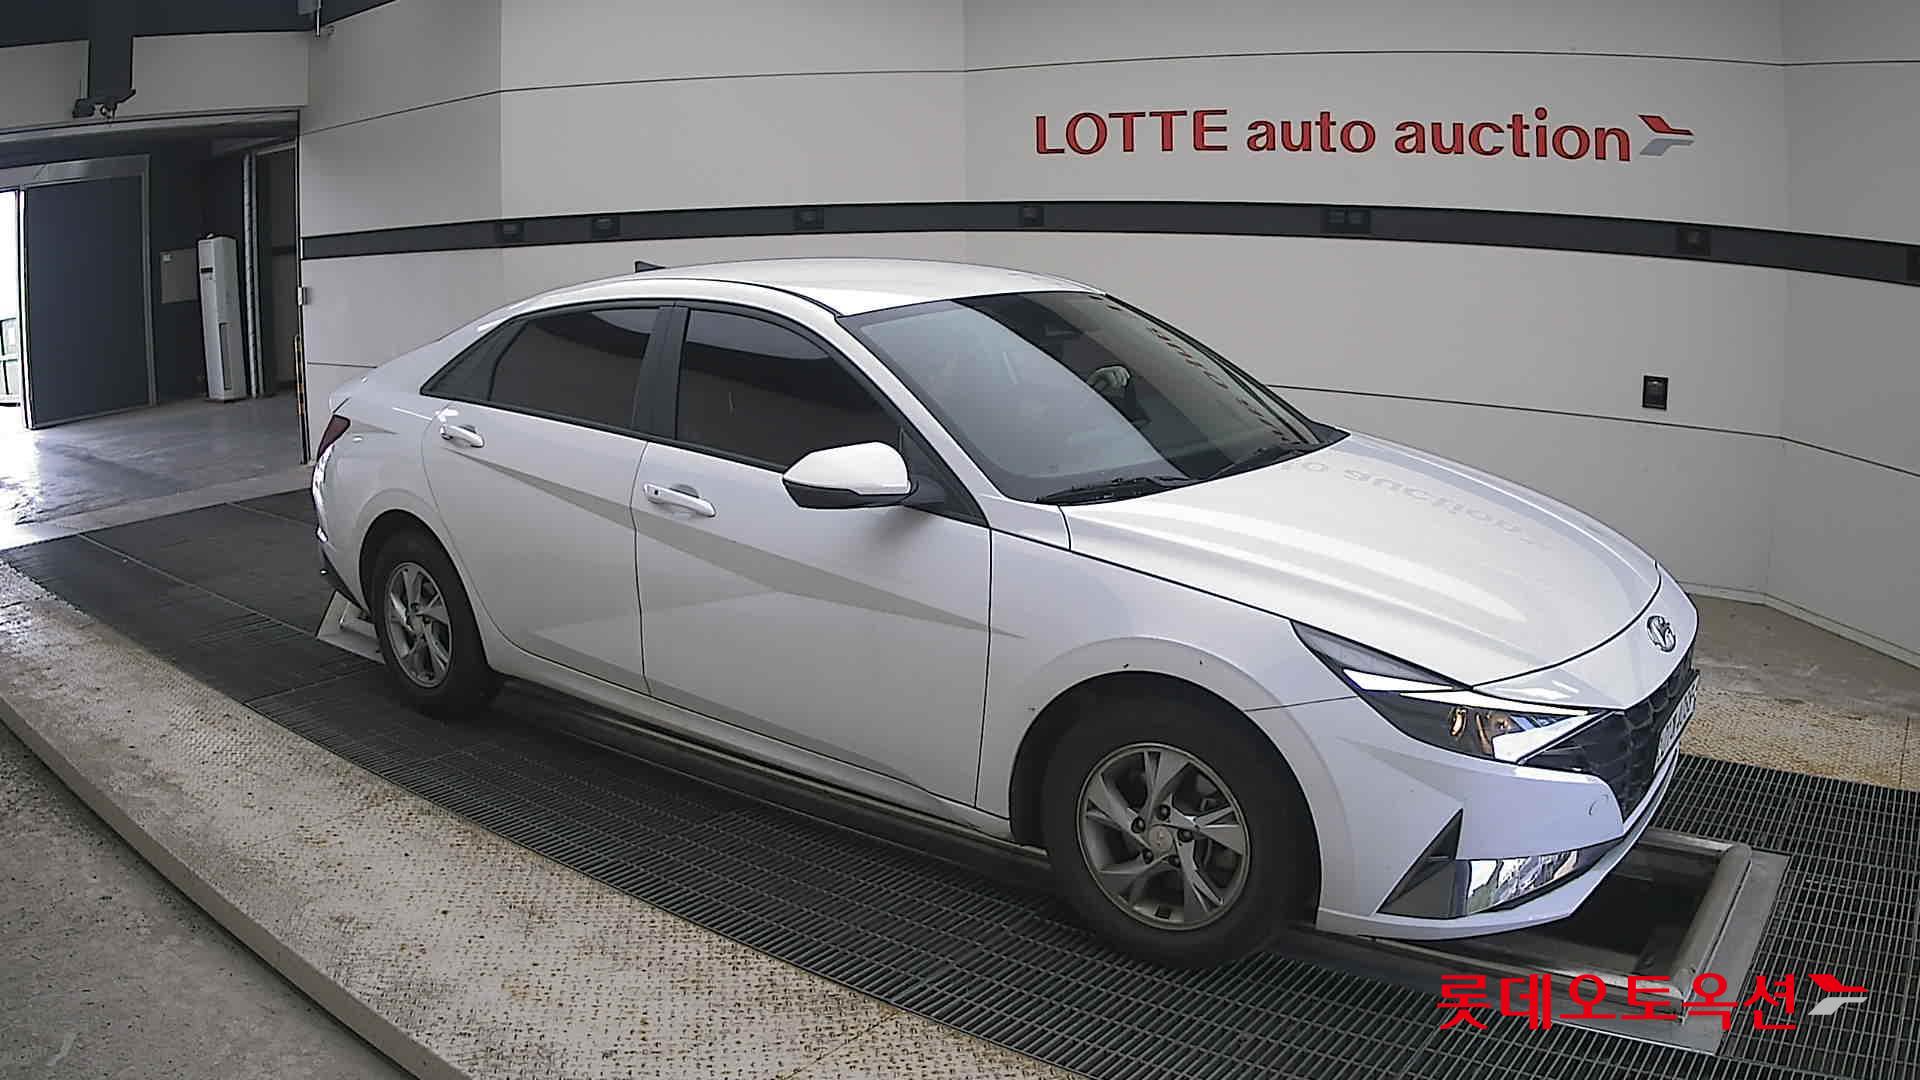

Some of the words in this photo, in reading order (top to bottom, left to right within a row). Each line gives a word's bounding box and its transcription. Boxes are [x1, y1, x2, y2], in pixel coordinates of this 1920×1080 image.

[1034, 109, 1229, 155] LOTTE
[1246, 111, 1377, 154] auto
[1395, 107, 1631, 162] auction
